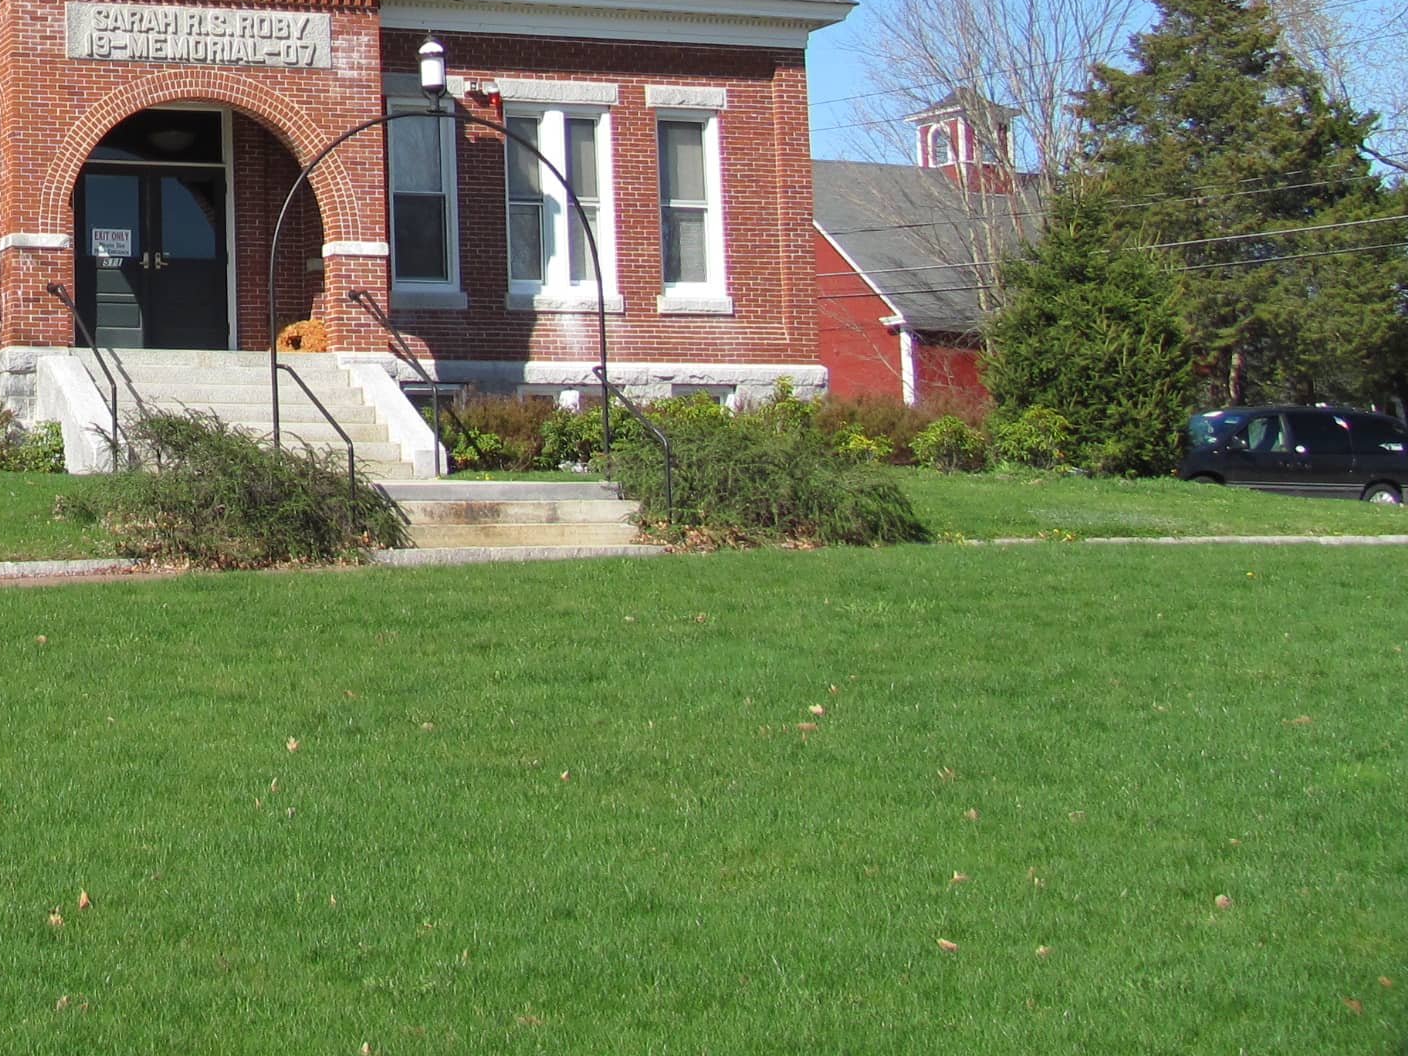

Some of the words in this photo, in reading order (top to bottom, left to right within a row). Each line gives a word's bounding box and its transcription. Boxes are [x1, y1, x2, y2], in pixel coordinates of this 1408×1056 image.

[92, 7, 178, 35] SARAH
[237, 12, 310, 41] ROBY
[95, 231, 109, 241] EXIT
[112, 231, 129, 241] ONLY
